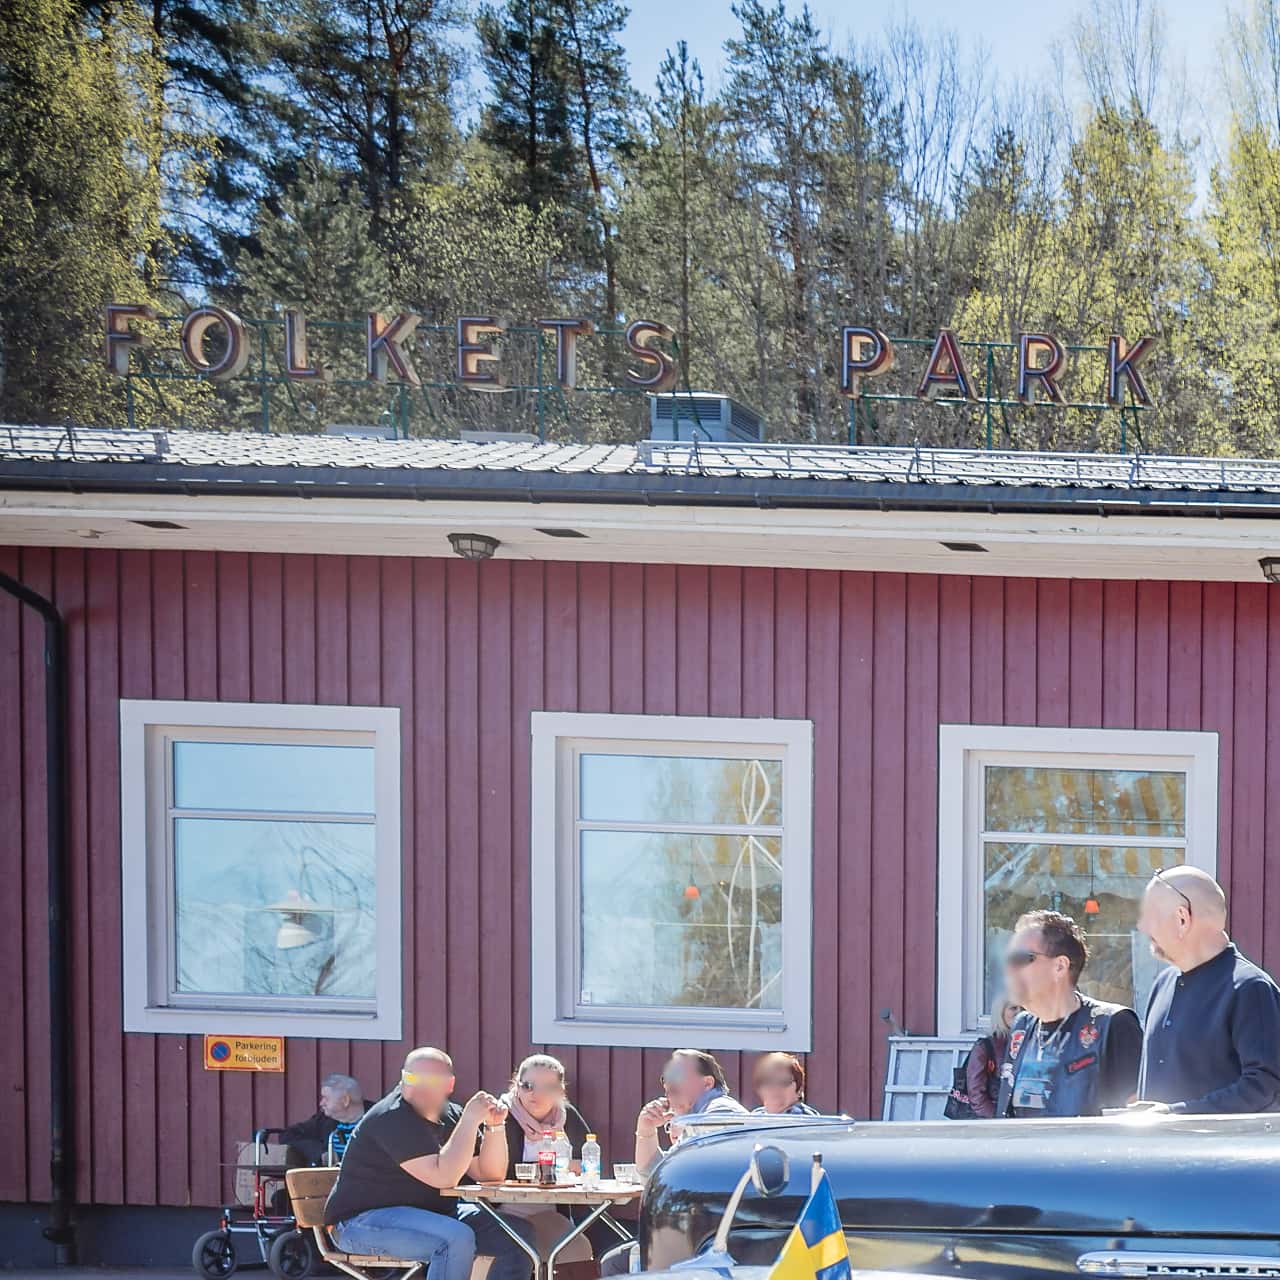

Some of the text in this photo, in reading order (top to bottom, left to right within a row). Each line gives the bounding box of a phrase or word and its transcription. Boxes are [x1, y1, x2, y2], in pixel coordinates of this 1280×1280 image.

[105, 303, 1152, 408] FOLKETS PARK
[235, 1041, 277, 1052] Parkering
